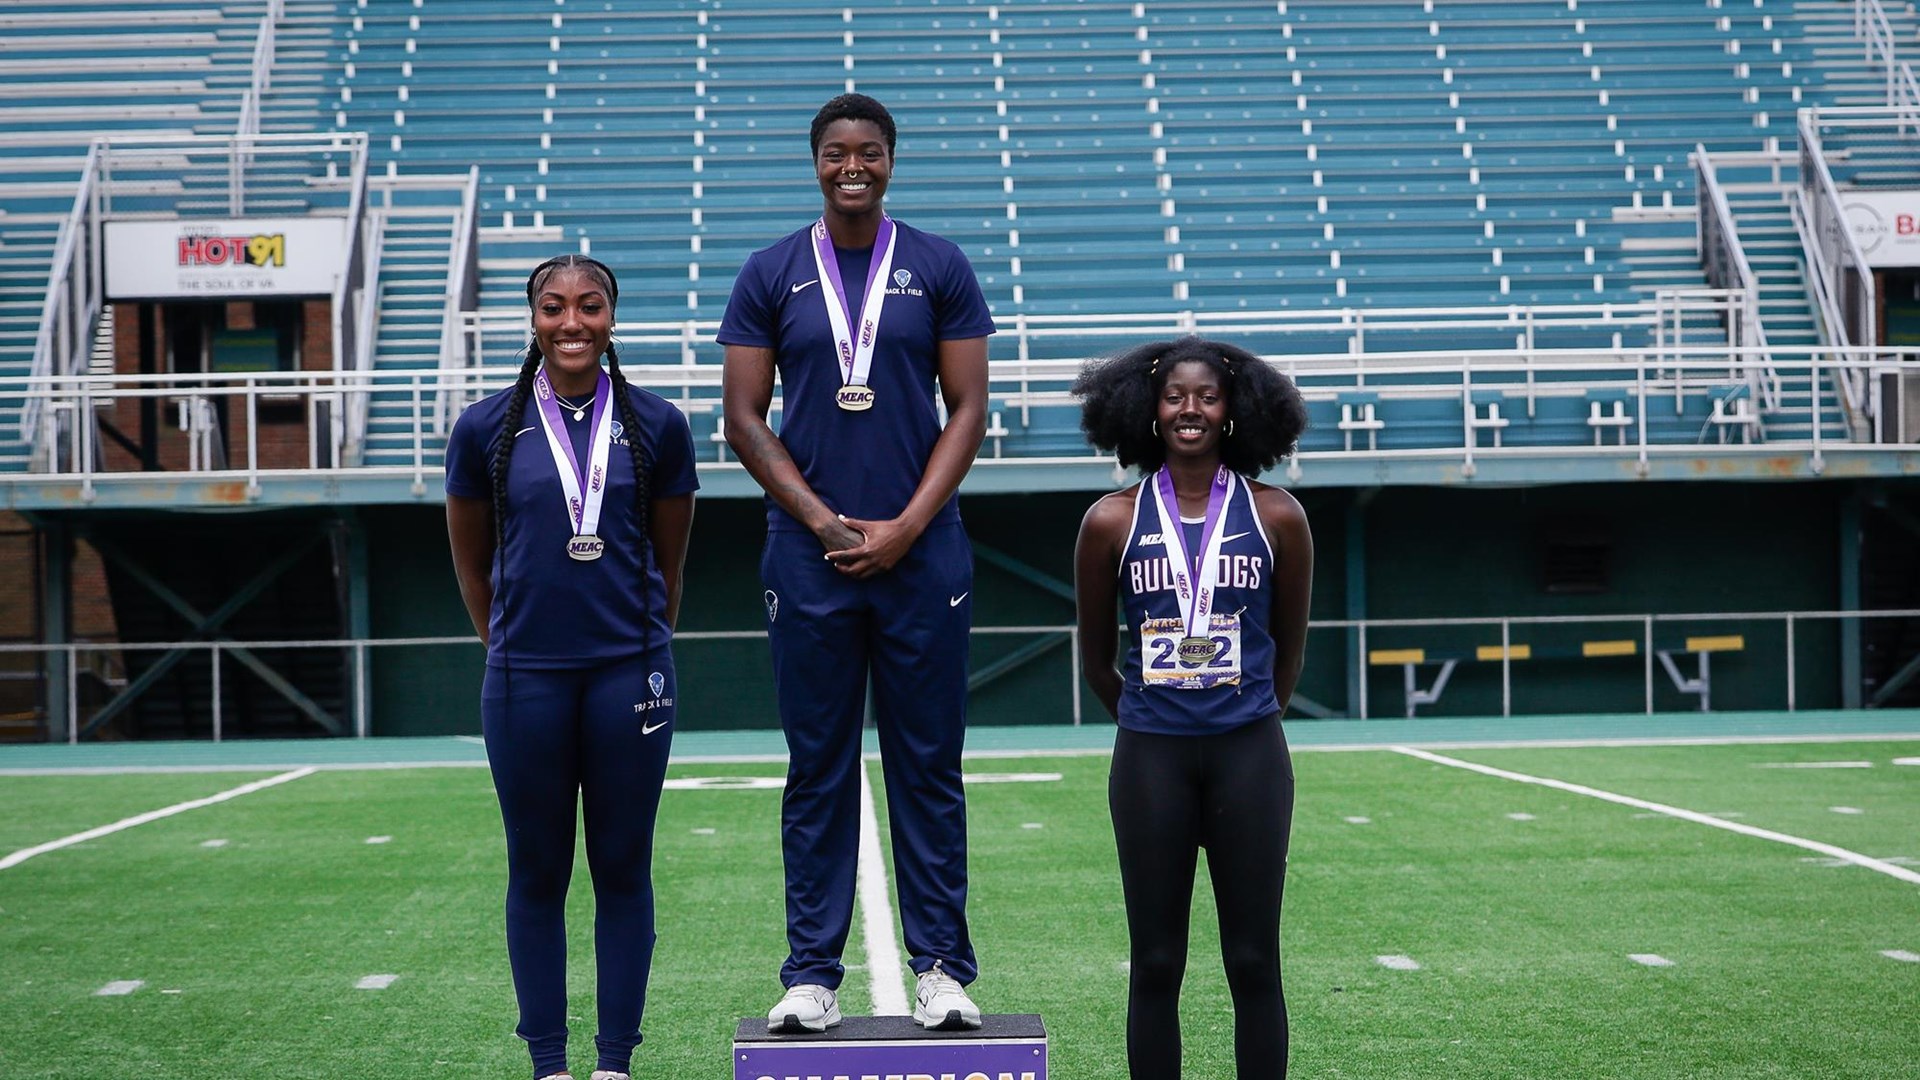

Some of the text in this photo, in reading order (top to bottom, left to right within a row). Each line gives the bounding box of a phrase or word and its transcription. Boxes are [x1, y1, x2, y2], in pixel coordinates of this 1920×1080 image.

[862, 320, 873, 348] MEAC
[840, 341, 851, 367] MEAC
[840, 391, 874, 403] MEAC
[592, 465, 601, 491] MEAC
[570, 541, 603, 553] MEAC
[1139, 533, 1166, 546] MEA
[1130, 555, 1262, 594] BULOGS
[1177, 572, 1190, 600] MEAC
[1199, 587, 1209, 615] MEAC
[1150, 636, 1233, 669] 22
[1181, 644, 1216, 655] MEAC
